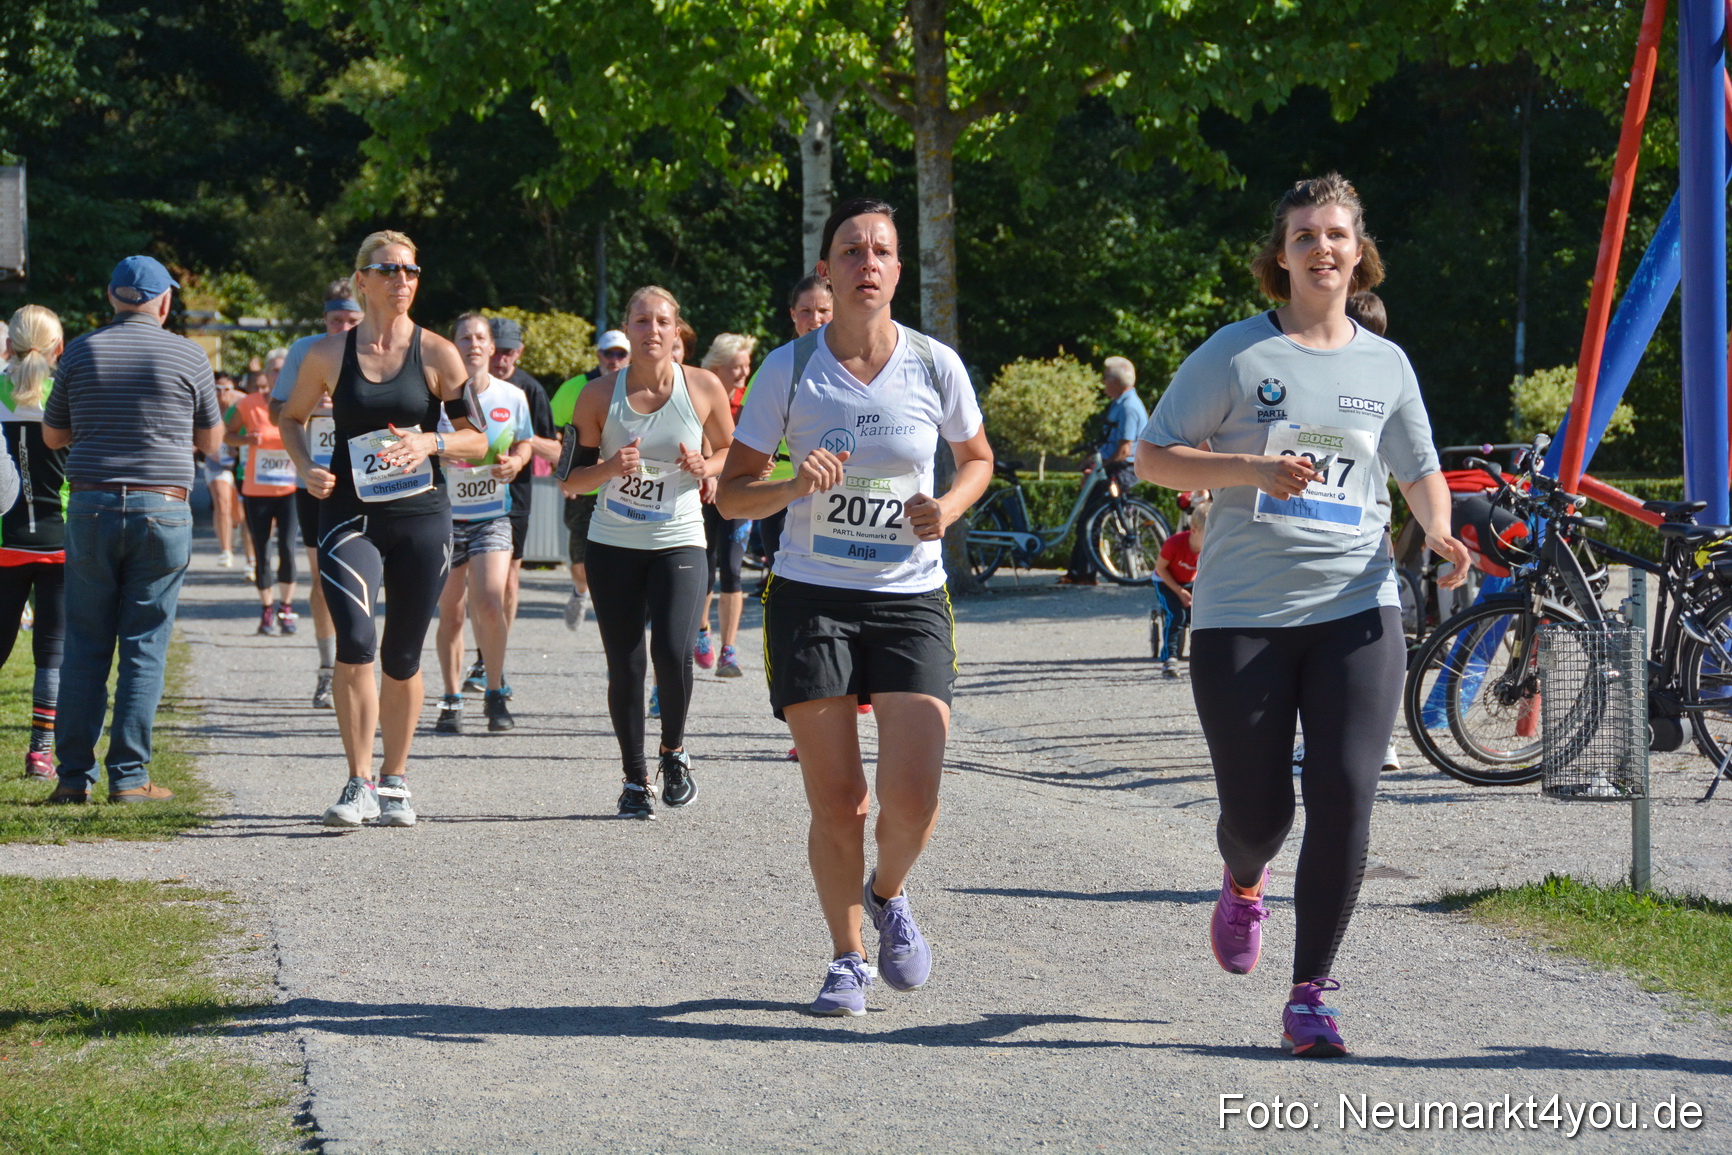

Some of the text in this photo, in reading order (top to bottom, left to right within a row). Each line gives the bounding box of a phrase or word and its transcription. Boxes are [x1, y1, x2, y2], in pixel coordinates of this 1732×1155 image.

[1338, 396, 1385, 414] BOCK
[856, 414, 880, 427] pro
[1258, 409, 1288, 418] PARTL
[860, 424, 916, 437] karriere
[1297, 432, 1344, 448] BOCK
[261, 457, 291, 470] 2007
[373, 480, 419, 494] Christiane
[457, 479, 497, 498] 3020
[619, 474, 665, 502] 2321
[846, 475, 891, 491] BOCK
[1305, 488, 1336, 499] Neumarkt
[627, 509, 647, 521] Nina
[827, 494, 903, 529] 2072
[832, 528, 887, 540] PARTL Neumarkt
[847, 544, 877, 560] Anja
